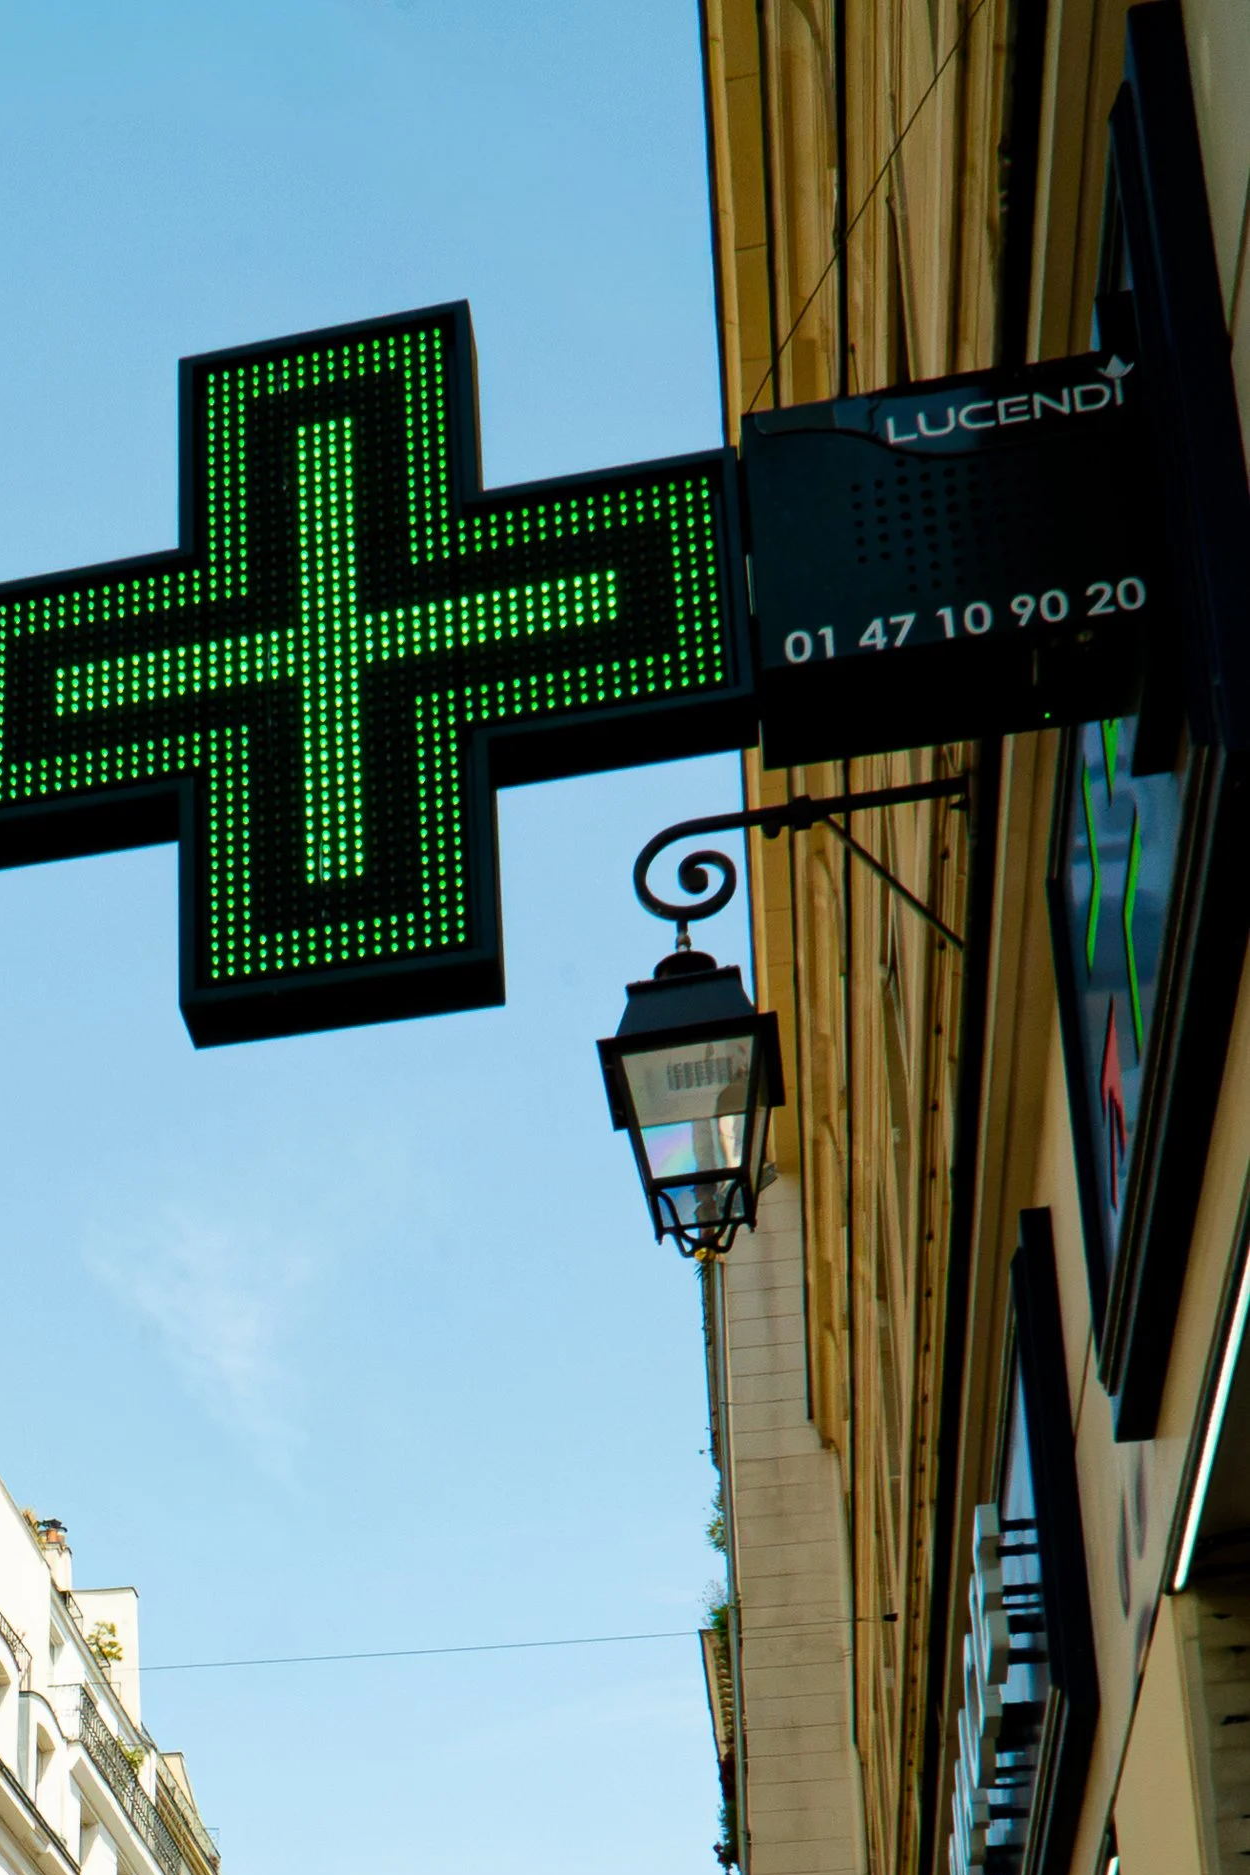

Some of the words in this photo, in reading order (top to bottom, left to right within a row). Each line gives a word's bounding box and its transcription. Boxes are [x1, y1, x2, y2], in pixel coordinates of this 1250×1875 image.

[784, 626, 835, 664] 01
[858, 613, 916, 651] 47
[937, 602, 993, 639] 10
[1011, 590, 1069, 627] 90
[1085, 577, 1146, 617] 20
